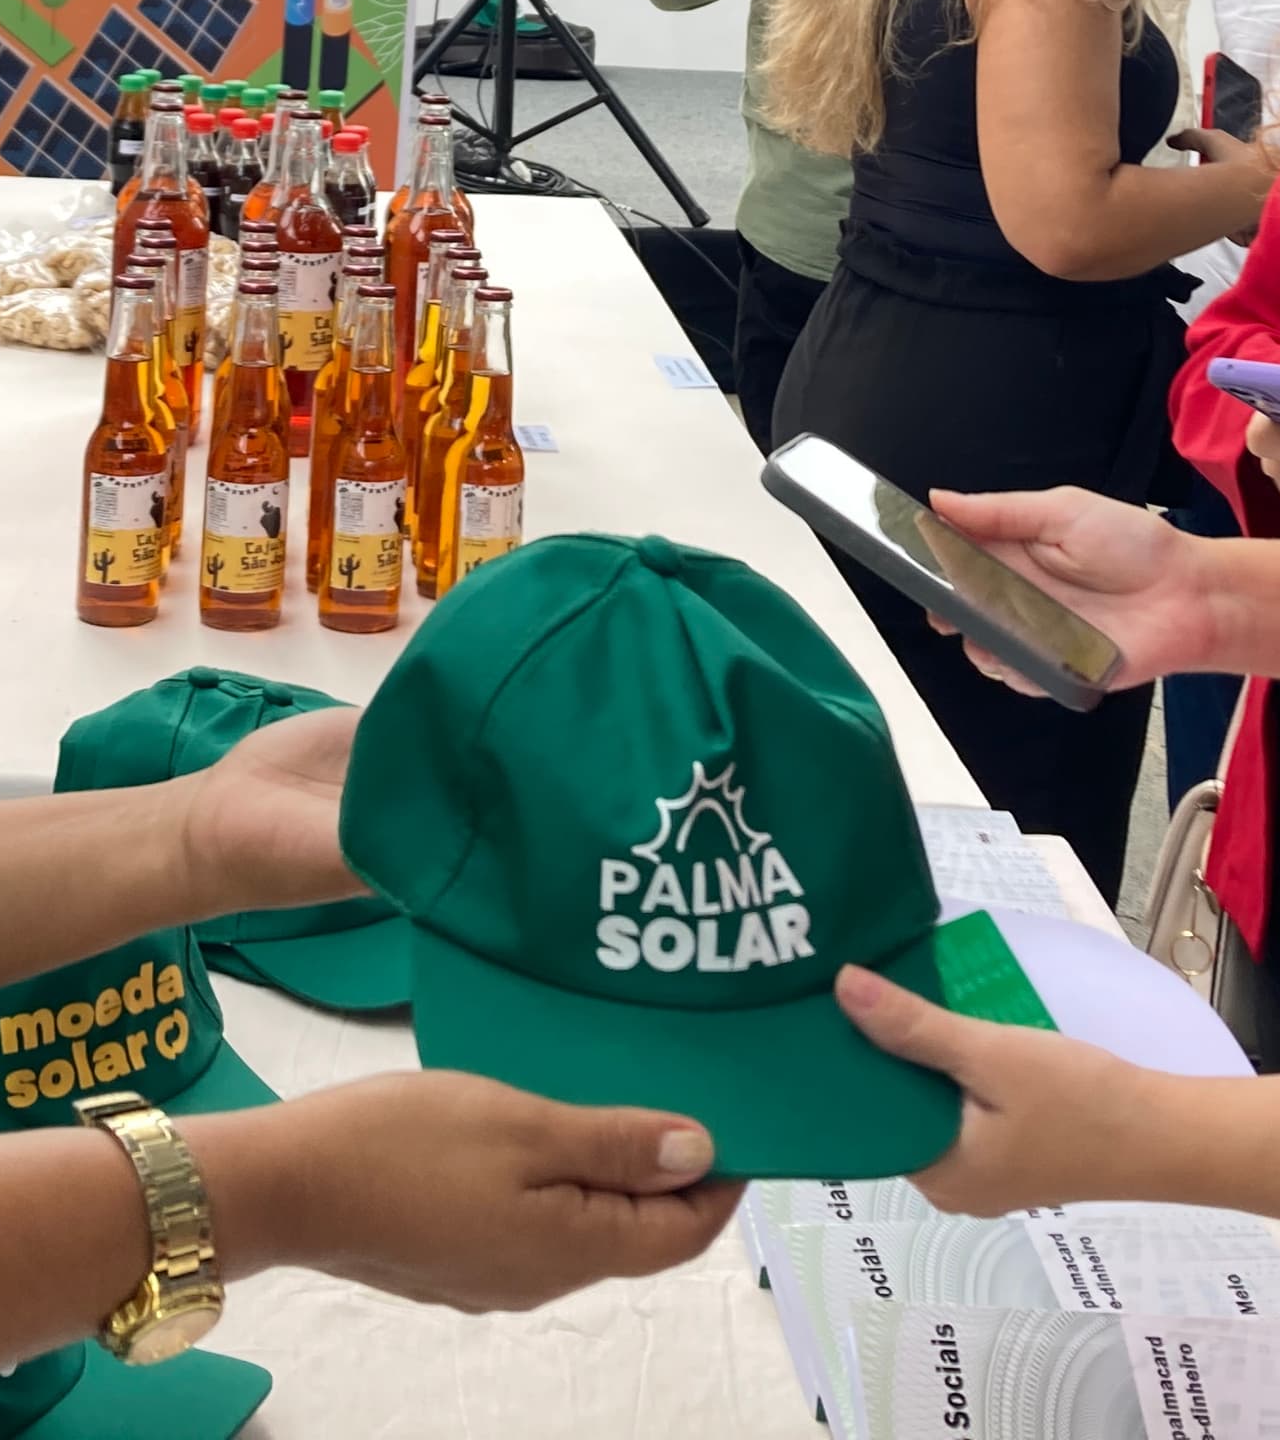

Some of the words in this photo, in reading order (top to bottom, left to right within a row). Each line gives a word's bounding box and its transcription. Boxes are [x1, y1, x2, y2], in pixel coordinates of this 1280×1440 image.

[600, 847, 805, 916] PALMA
[596, 903, 816, 972] SOLAR
[4, 1030, 148, 1109] solar
[854, 1236, 893, 1299] ociais
[1048, 1232, 1100, 1309] palmacard
[1080, 1236, 1122, 1310] e-dinheiro
[931, 1323, 970, 1430] Sociais
